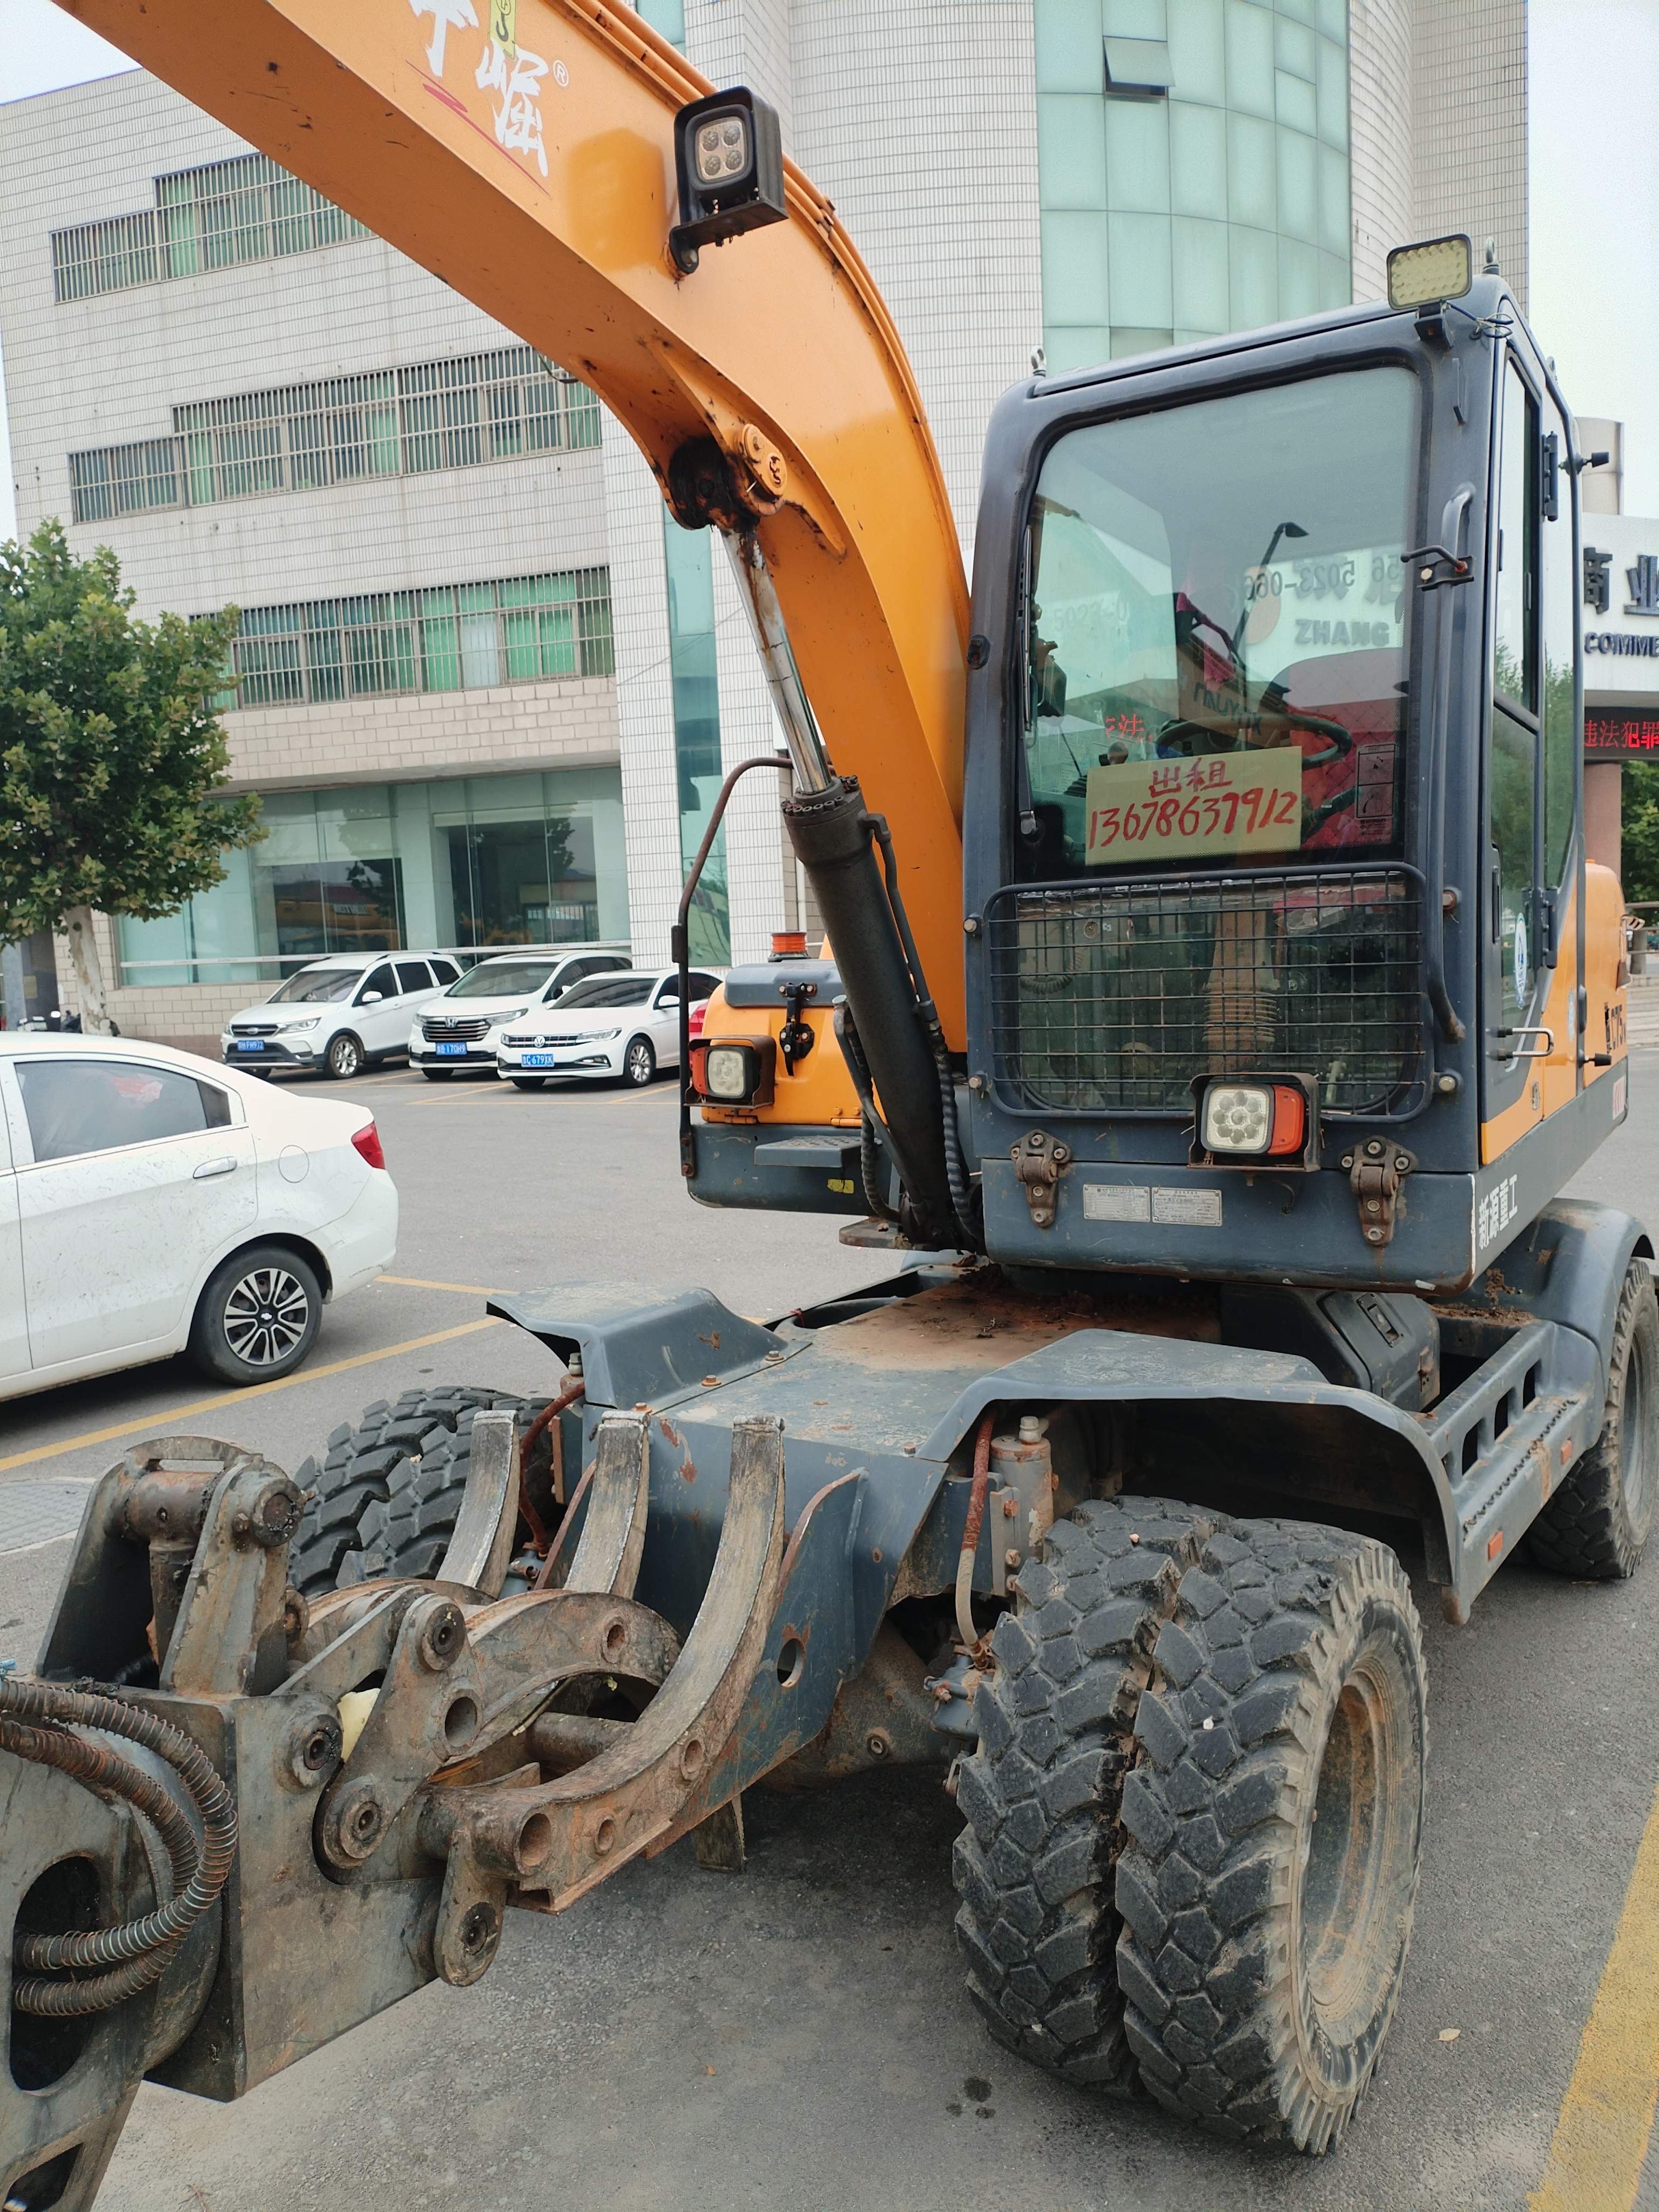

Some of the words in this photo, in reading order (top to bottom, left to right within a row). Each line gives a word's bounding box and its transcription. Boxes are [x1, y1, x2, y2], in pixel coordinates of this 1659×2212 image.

[1295, 619, 1390, 646] ZHANG
[1149, 757, 1232, 797] 出租
[1089, 788, 1298, 850] 13678637912
[1479, 1174, 1518, 1250] 新源重工
